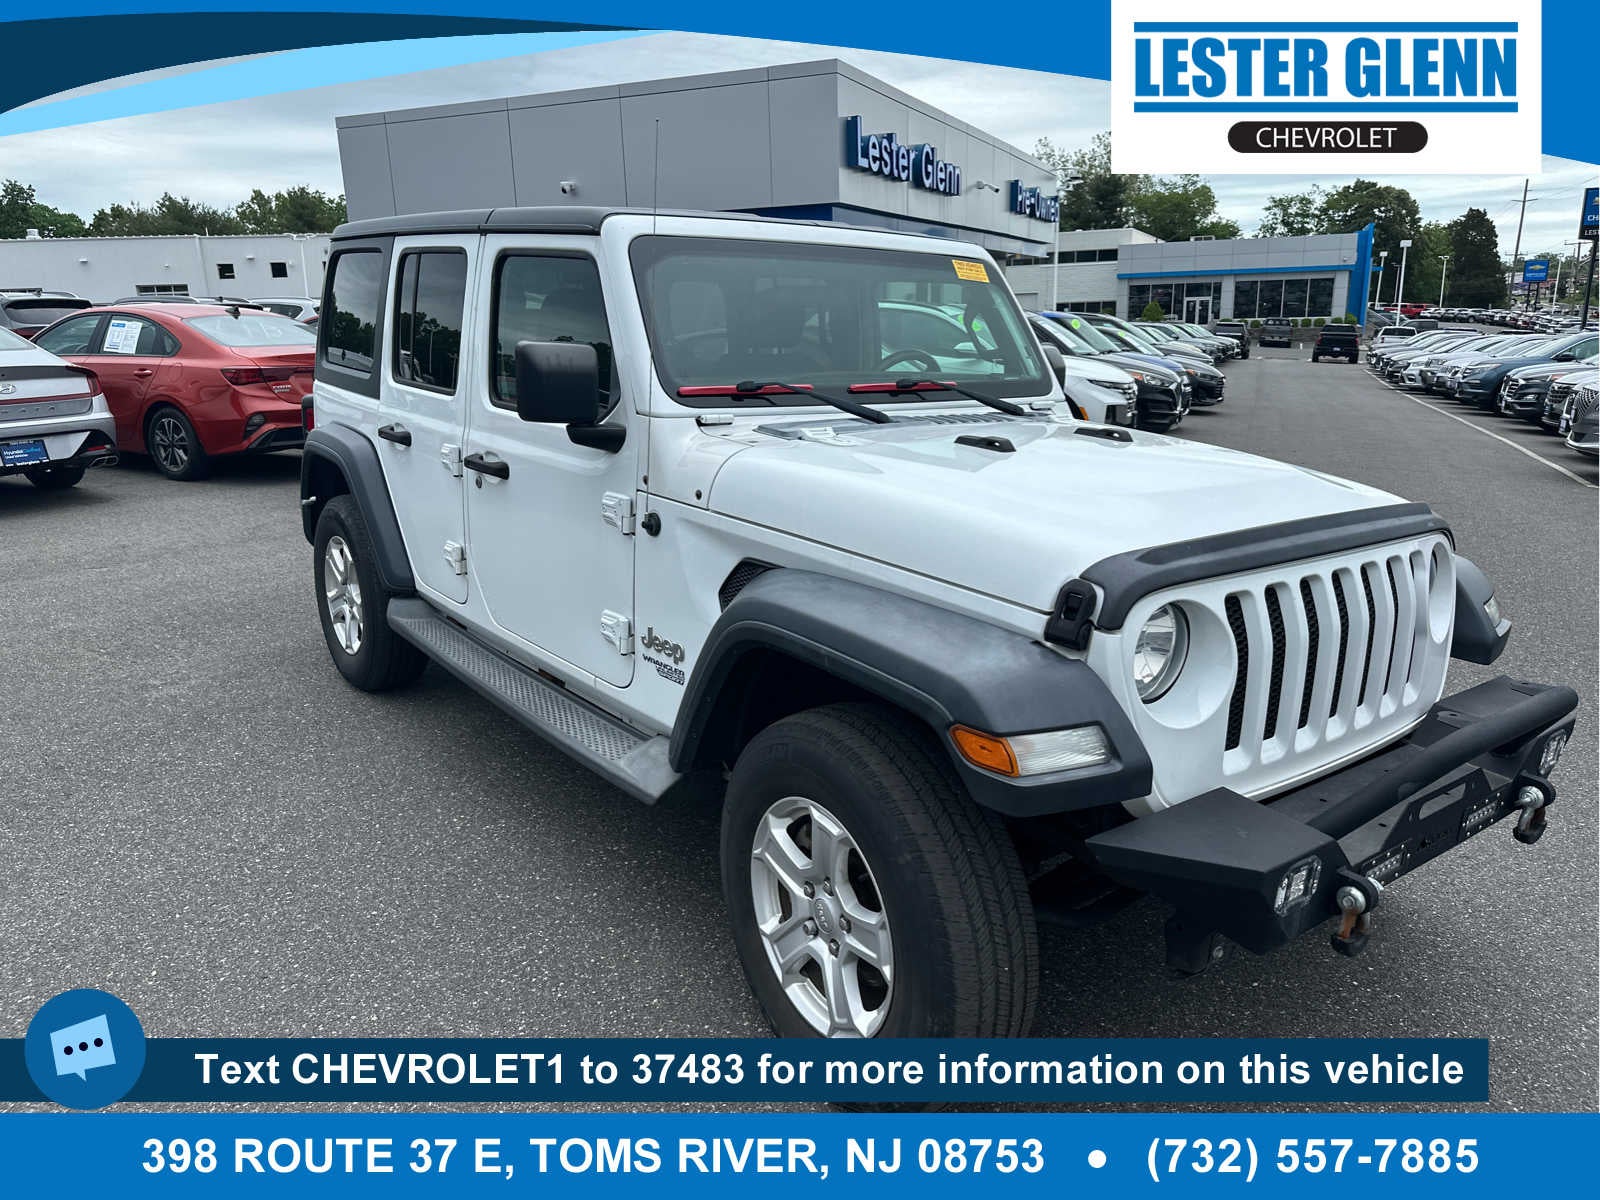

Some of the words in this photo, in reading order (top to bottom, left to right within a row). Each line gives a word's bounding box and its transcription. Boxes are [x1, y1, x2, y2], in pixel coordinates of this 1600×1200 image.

[848, 114, 918, 183] Lester
[918, 142, 962, 197] Glenn
[640, 625, 686, 665] Jeep
[642, 653, 685, 677] WRANGLER
